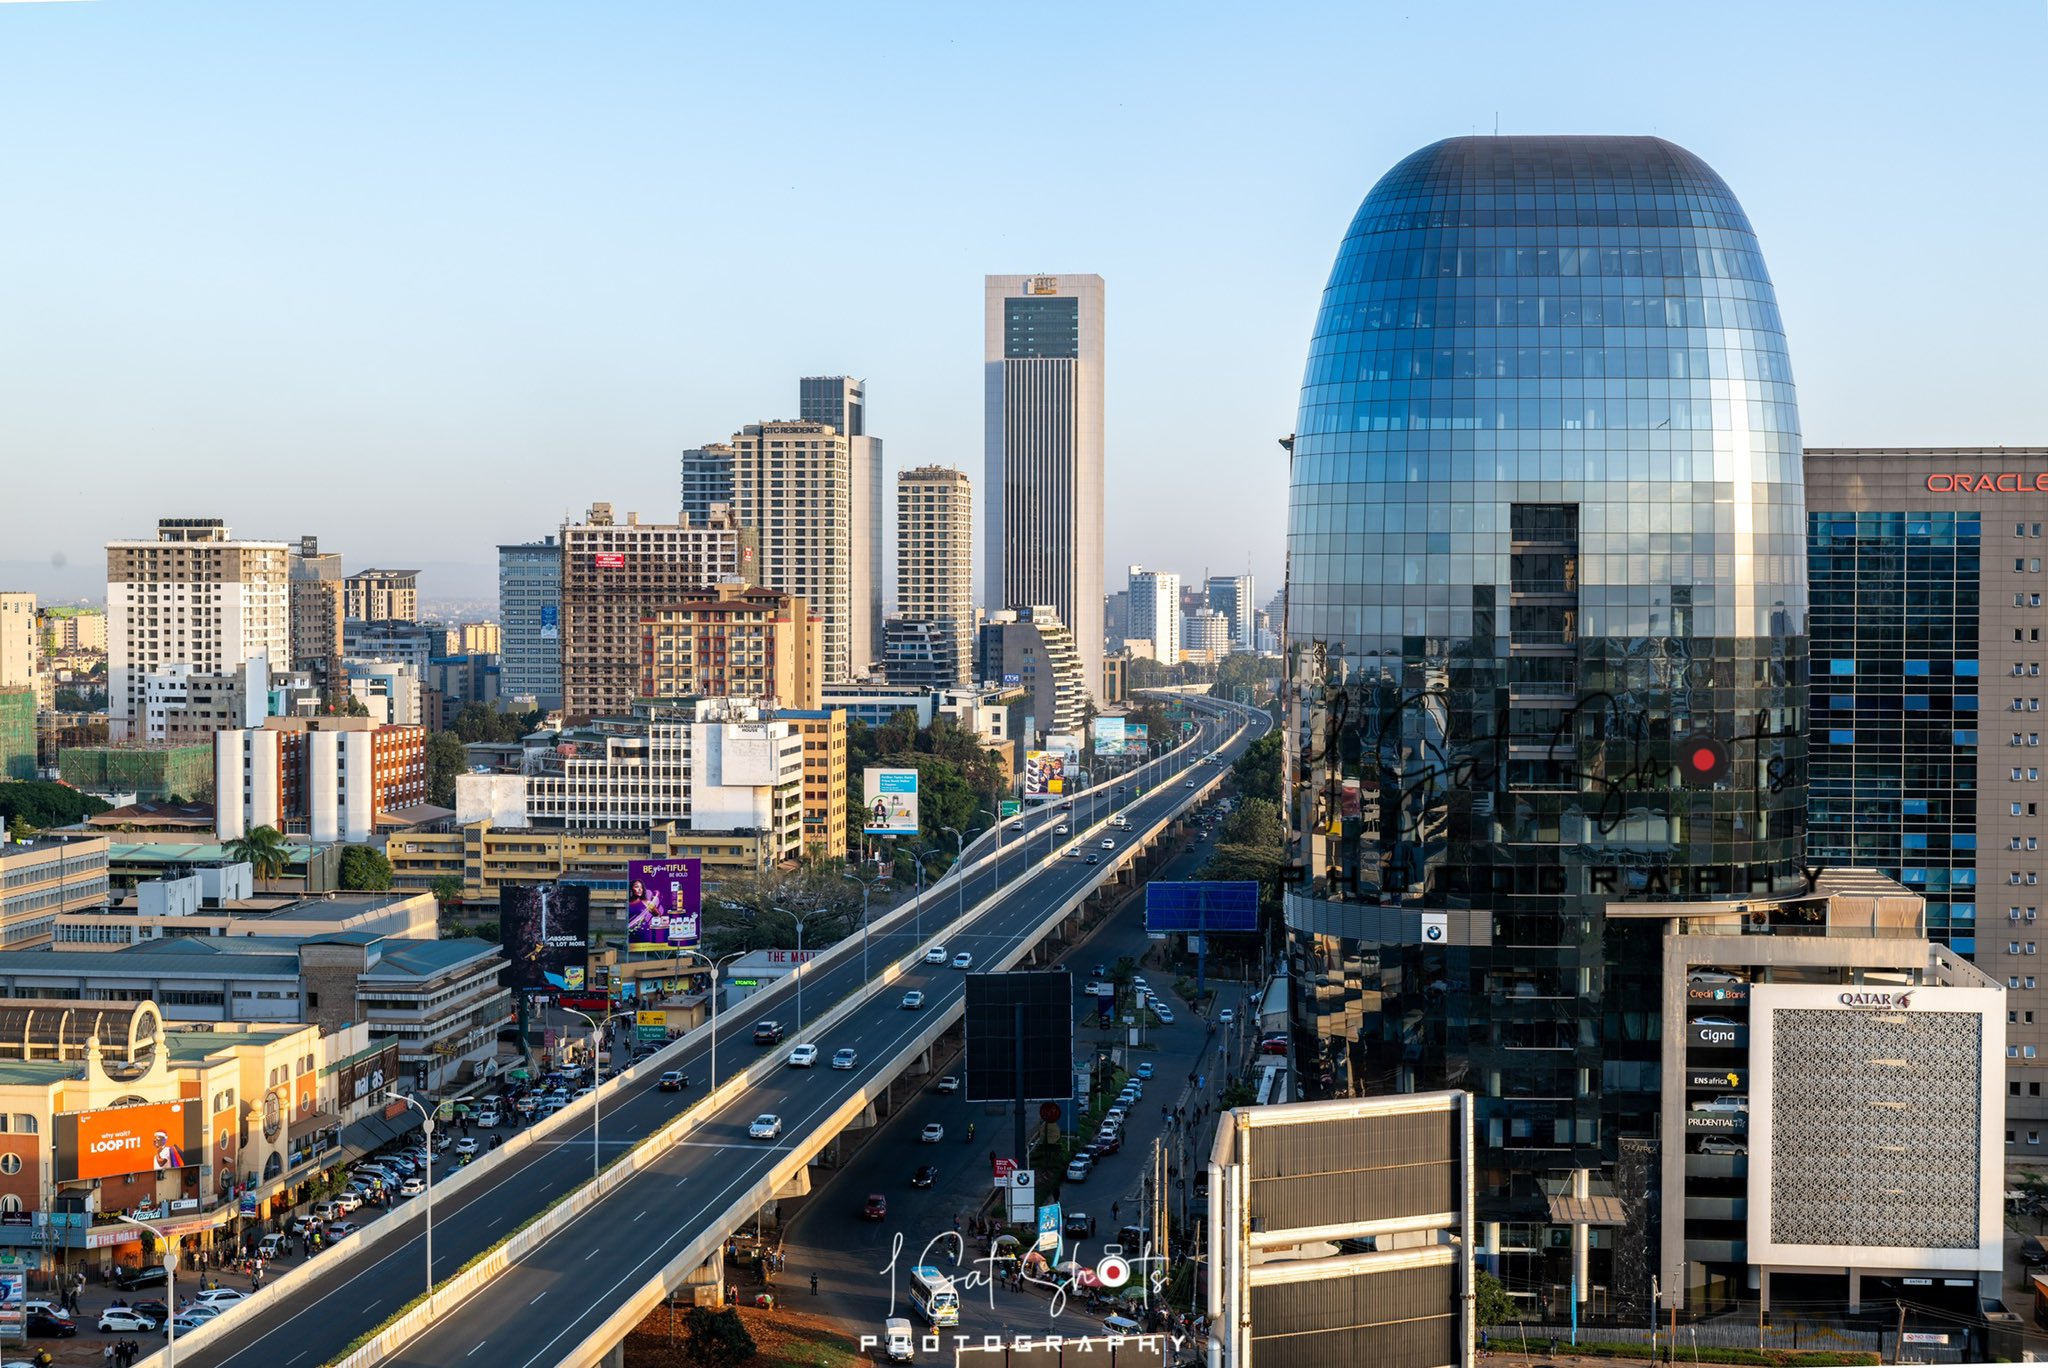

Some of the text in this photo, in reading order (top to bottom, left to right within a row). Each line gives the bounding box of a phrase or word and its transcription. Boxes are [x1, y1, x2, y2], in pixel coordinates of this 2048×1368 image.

[1926, 473, 2048, 493] ORACLE
[767, 951, 786, 962] THE
[1690, 989, 1746, 998] Credit Bank
[1839, 992, 1891, 1006] QATAR
[1700, 1029, 1735, 1043] Cigna
[1688, 1118, 1734, 1126] PRUDENTIAL
[90, 1136, 141, 1153] LOOP IT!
[98, 1230, 139, 1244] THE MALL
